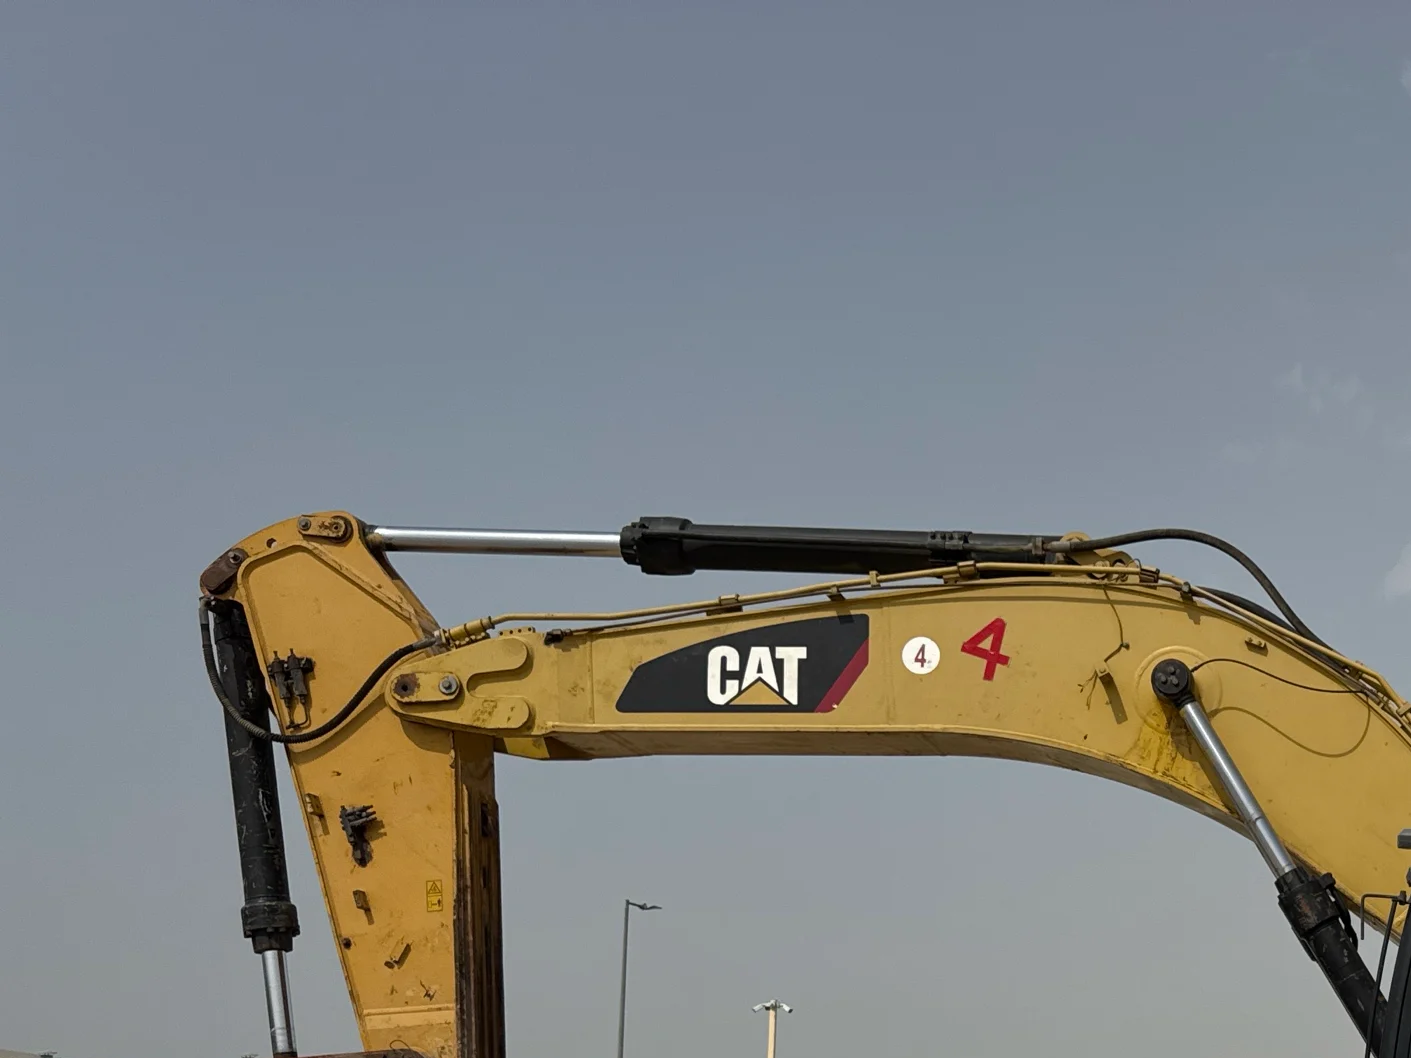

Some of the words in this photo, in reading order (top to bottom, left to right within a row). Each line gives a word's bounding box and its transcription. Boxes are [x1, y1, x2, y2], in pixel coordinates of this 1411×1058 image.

[706, 645, 808, 706] CAT
[914, 644, 926, 667] 4
[961, 617, 1010, 681] 4
